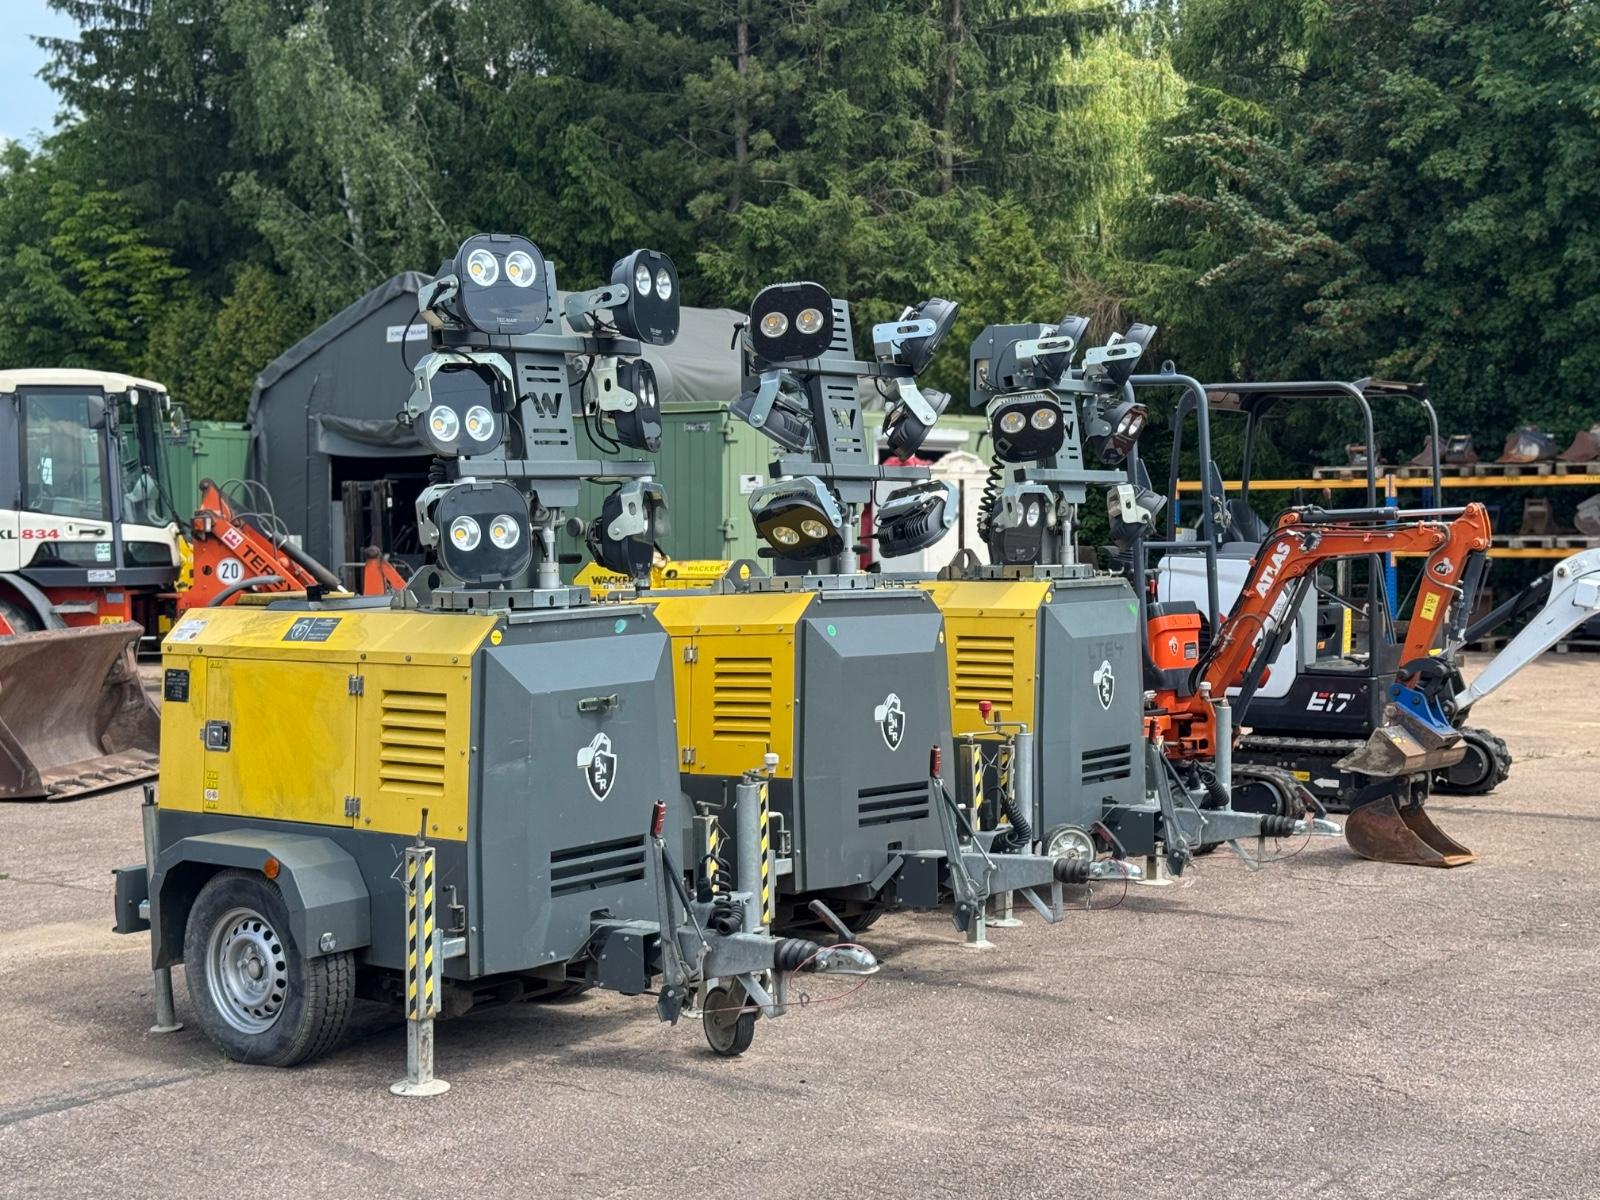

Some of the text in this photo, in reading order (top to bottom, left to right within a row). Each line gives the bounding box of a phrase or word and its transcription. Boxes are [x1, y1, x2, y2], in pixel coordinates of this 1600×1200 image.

[527, 392, 563, 418] W
[21, 529, 60, 539] 834
[222, 563, 239, 579] 20
[1255, 542, 1291, 599] ATLAS
[594, 756, 607, 791] BNER
